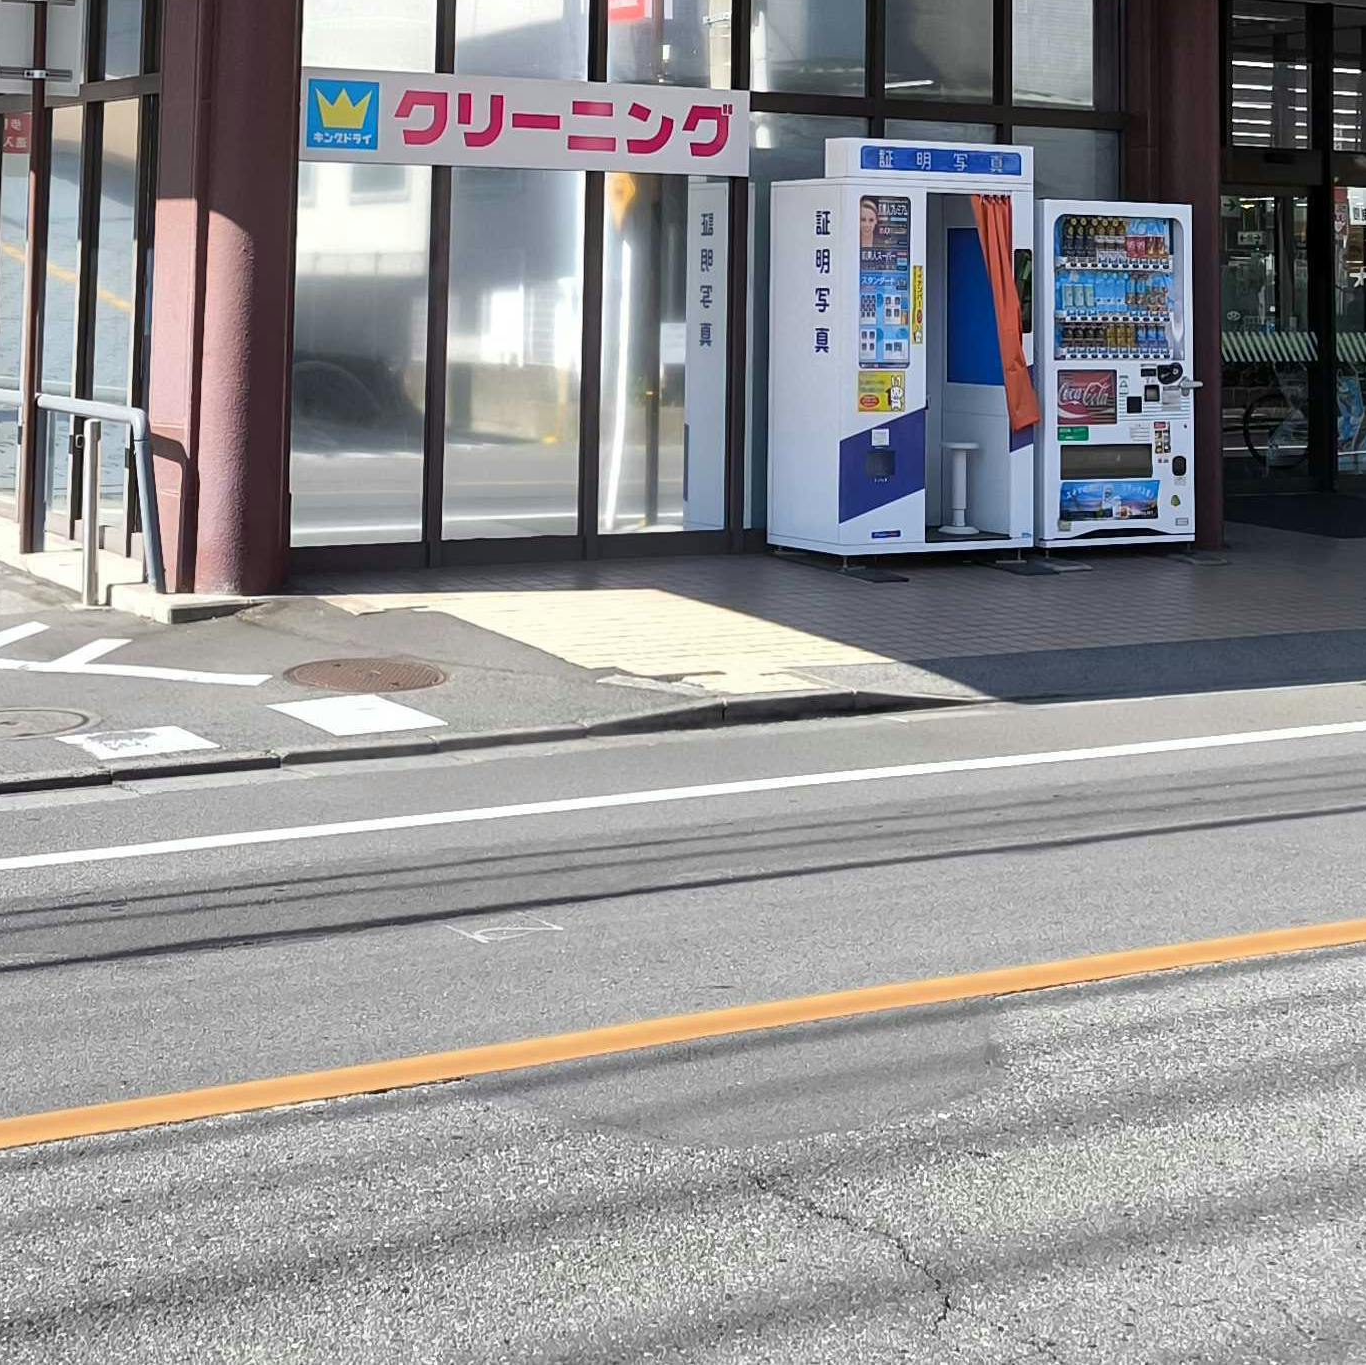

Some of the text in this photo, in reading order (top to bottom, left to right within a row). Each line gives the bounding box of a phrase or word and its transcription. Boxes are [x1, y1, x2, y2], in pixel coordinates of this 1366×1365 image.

[313, 131, 372, 146] キングドライ
[394, 90, 733, 158] クリーニング
[879, 149, 1003, 173] 証明写真
[815, 210, 831, 354] 証明写真
